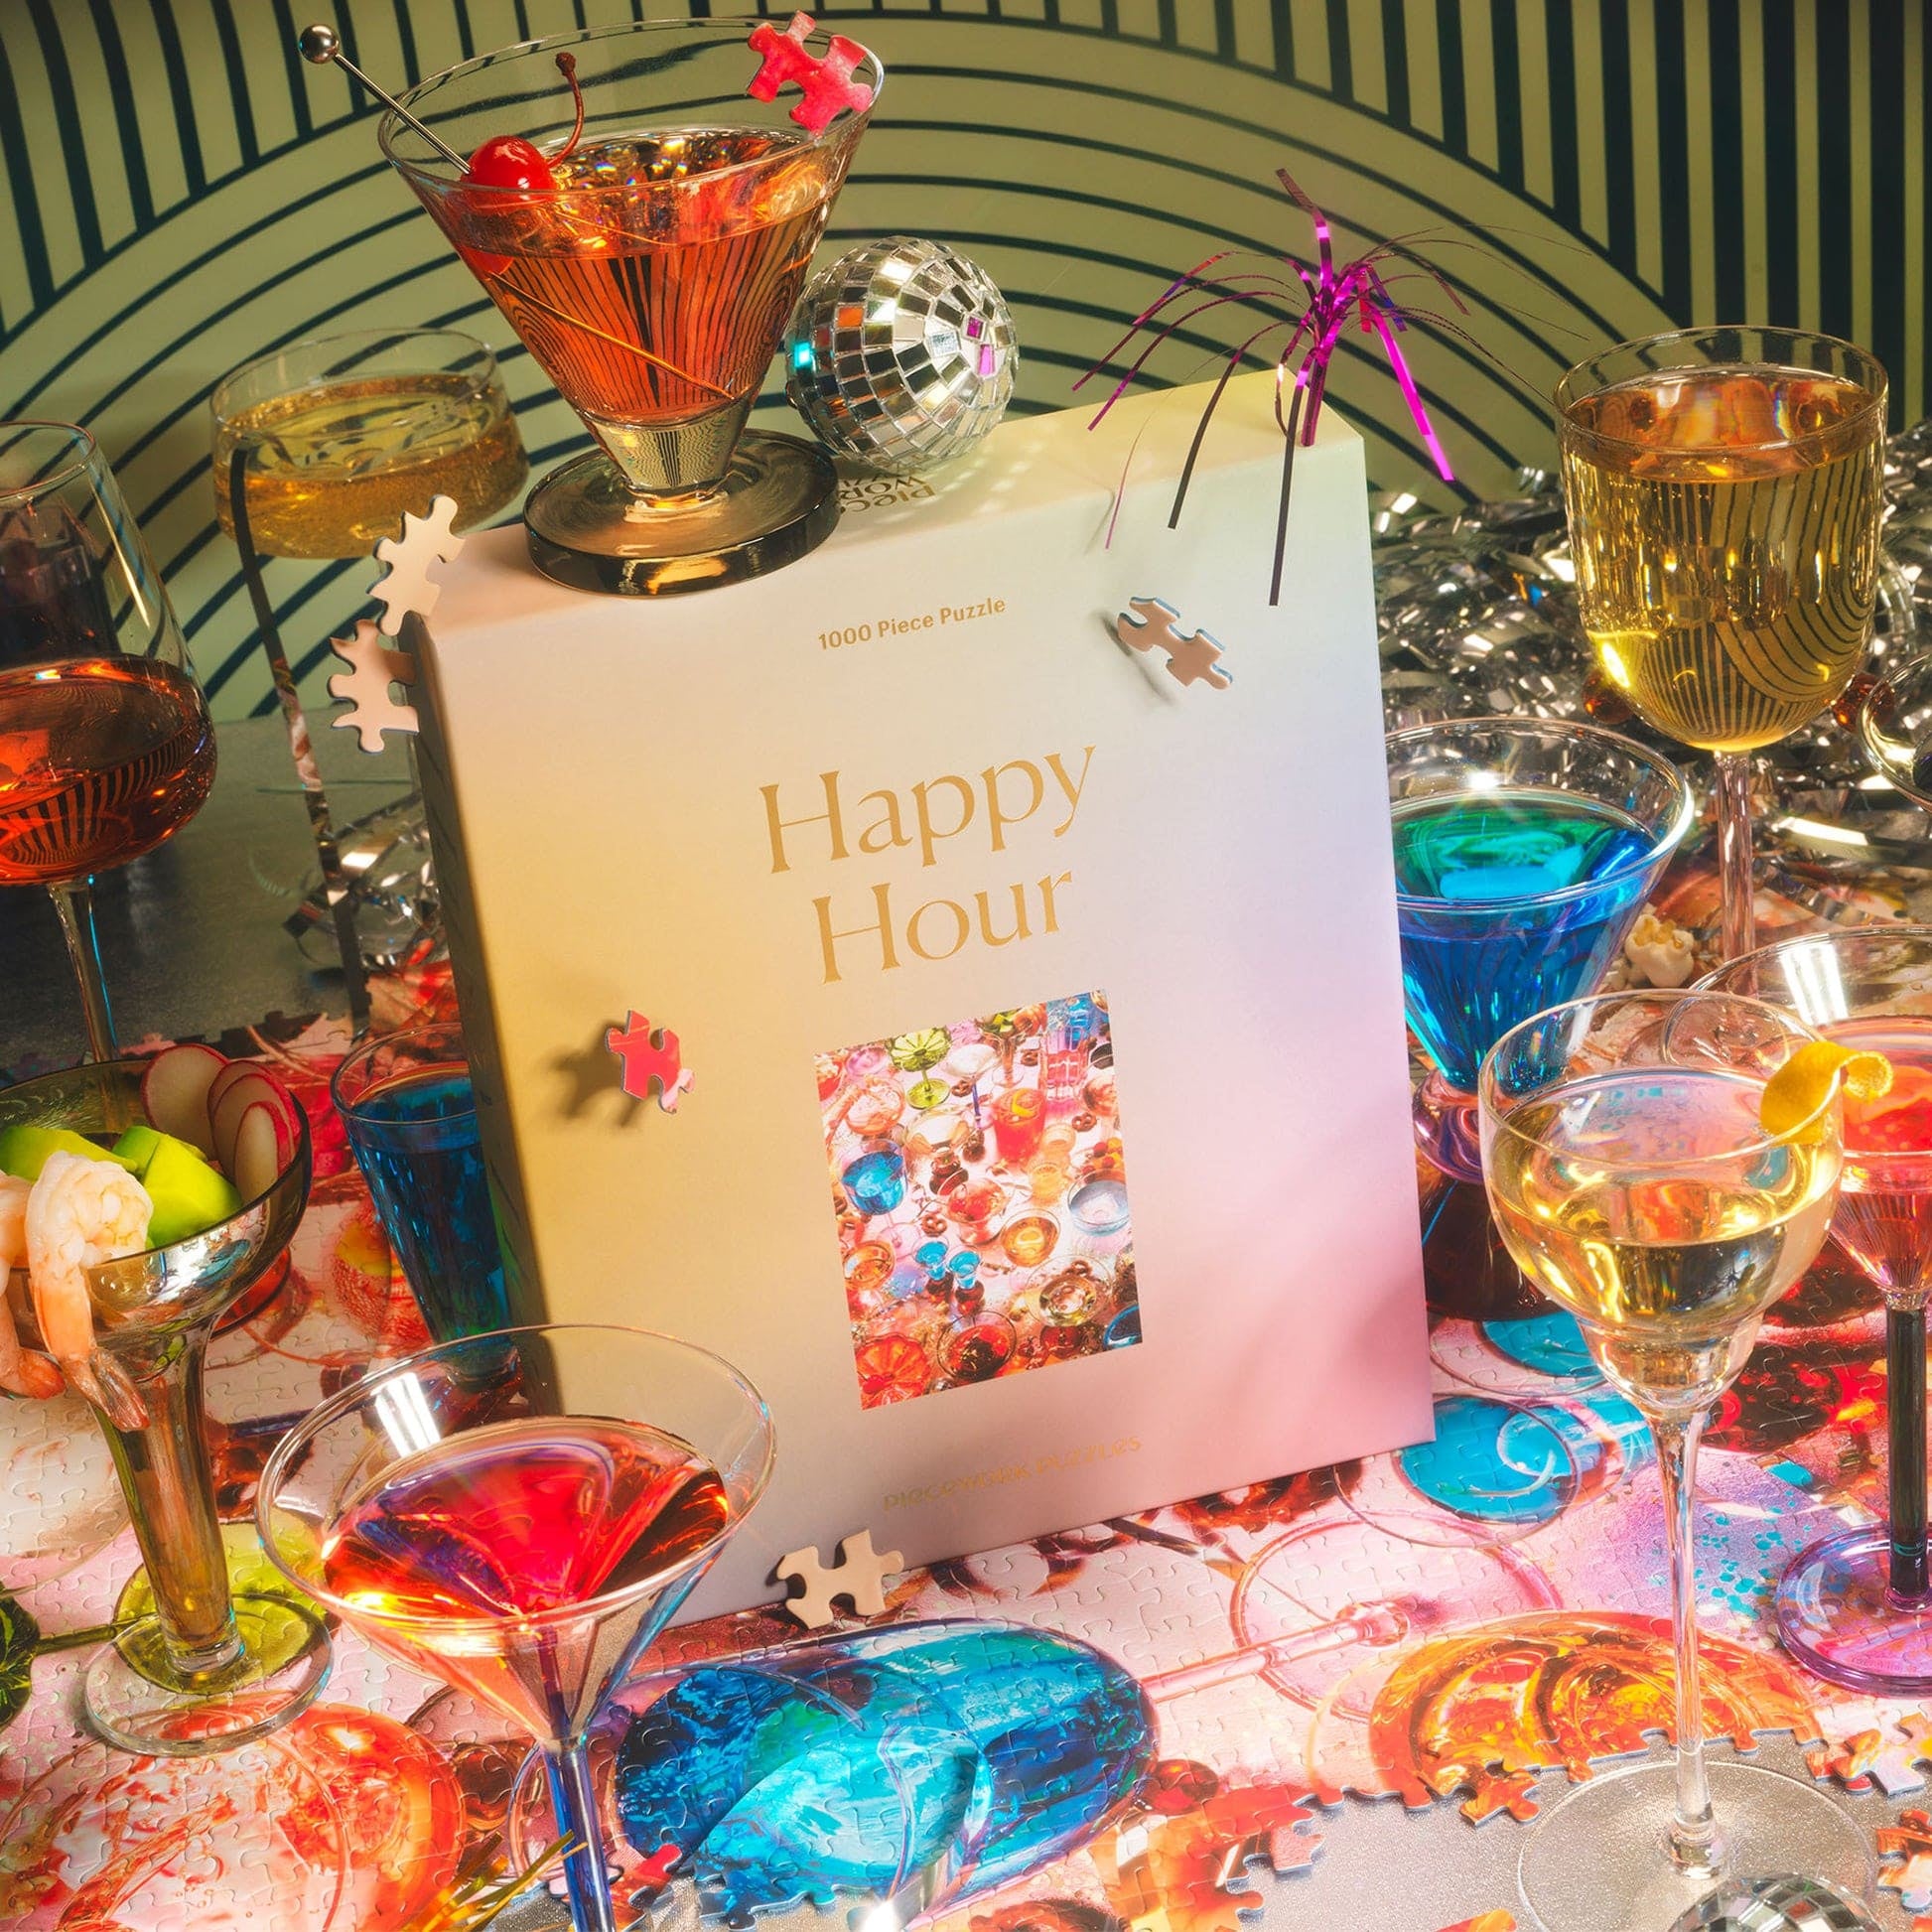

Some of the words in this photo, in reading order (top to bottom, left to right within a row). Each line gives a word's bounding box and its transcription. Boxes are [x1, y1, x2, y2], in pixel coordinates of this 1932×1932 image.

[837, 477, 926, 500] WOR
[818, 623, 872, 650] 1000
[878, 615, 934, 637] Piece
[939, 598, 1006, 624] Puzzle
[759, 746, 1096, 874] Happy
[811, 871, 1072, 985] Hour
